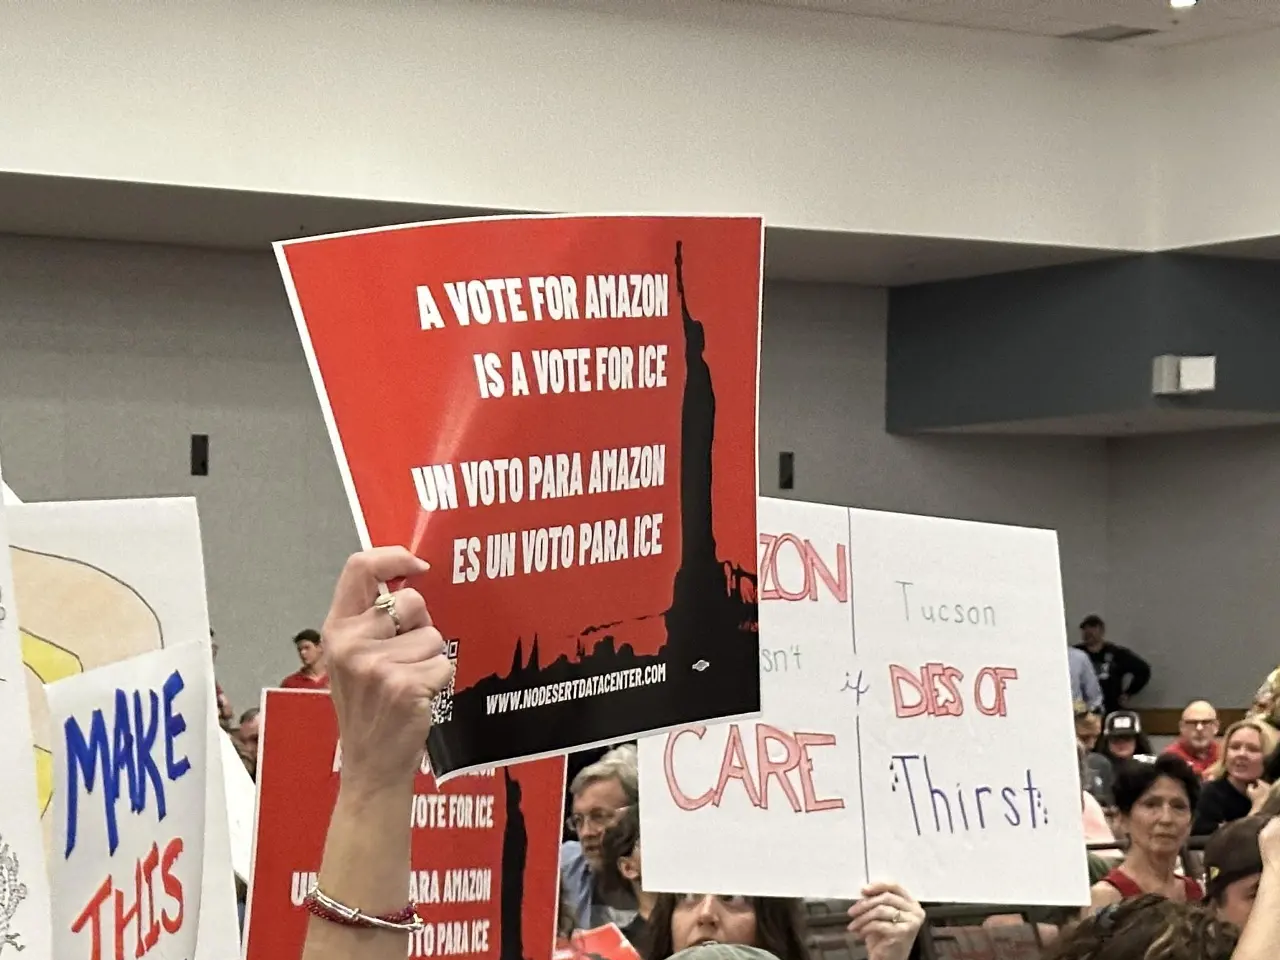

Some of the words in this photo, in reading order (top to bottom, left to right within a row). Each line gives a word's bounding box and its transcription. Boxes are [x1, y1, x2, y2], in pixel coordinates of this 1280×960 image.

[416, 285, 445, 331] A
[443, 277, 528, 327] VOTE
[528, 275, 580, 321] FOR
[585, 273, 669, 320] AMAZON
[473, 352, 505, 399] IS
[511, 351, 530, 397] A
[532, 348, 592, 395] VOTE
[596, 346, 634, 391] FOR
[638, 345, 668, 389] ICE
[411, 463, 458, 512] UN
[460, 457, 523, 507] VOTO
[528, 452, 583, 501] PARA
[588, 444, 666, 494] AMAZON
[452, 536, 481, 585] ES
[486, 532, 516, 580] UN
[521, 524, 575, 574] VOTO
[578, 518, 629, 566] PARA
[633, 513, 663, 558] ICE
[894, 579, 997, 628] Tucson
[486, 662, 666, 715] WWW.NODESERTDATACENTER.COM
[839, 669, 870, 706] if
[889, 662, 965, 719] DIES
[974, 666, 1018, 718] OF
[64, 668, 192, 860] MAKE
[663, 723, 846, 813] CARE
[449, 796, 473, 828] FOR
[475, 796, 494, 828] ICE
[891, 754, 1038, 837] Thirst
[443, 869, 492, 904] AMAZON
[437, 921, 469, 955] PARA
[472, 920, 490, 953] ICE
